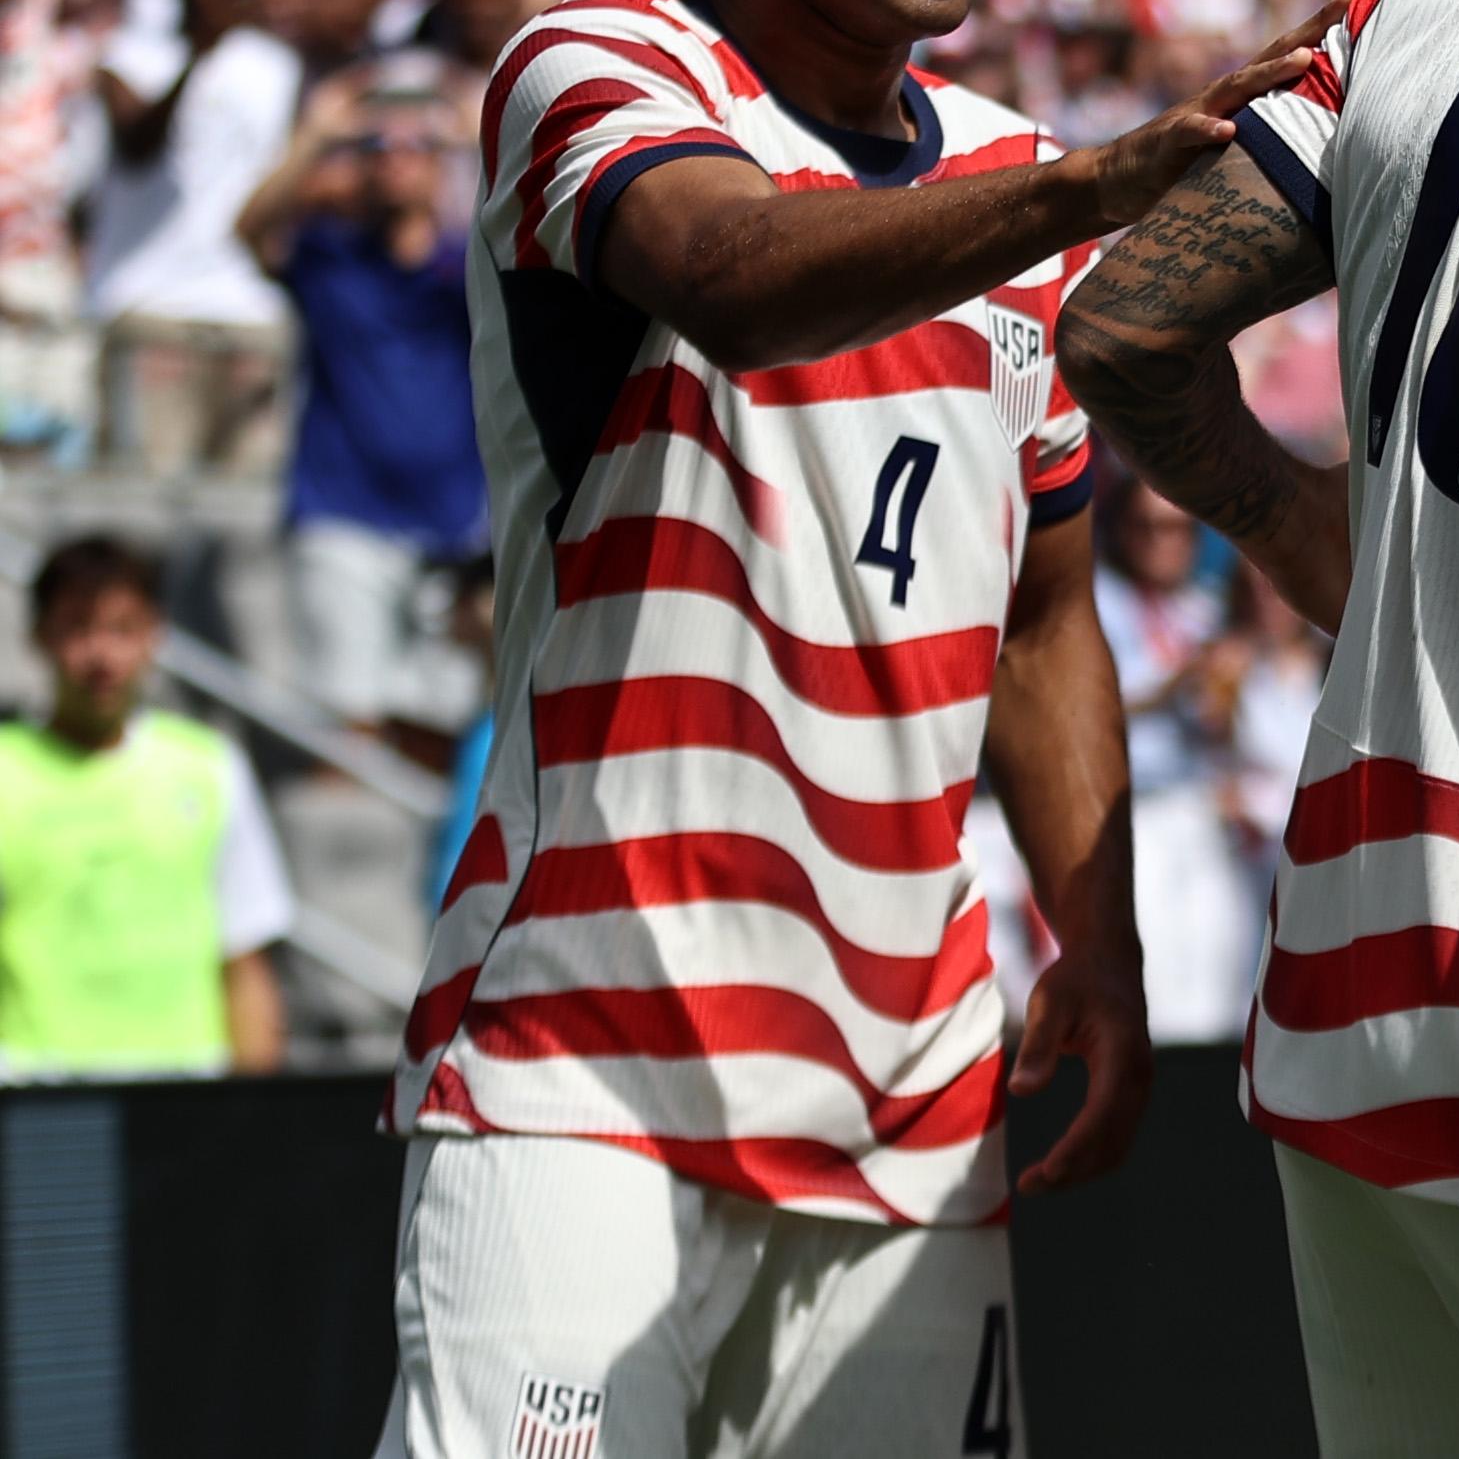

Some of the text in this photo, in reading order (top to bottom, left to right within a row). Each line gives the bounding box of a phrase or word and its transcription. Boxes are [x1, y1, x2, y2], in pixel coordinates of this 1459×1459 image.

[993, 314, 1039, 370] USA
[853, 435, 941, 611] 4
[526, 1380, 600, 1426] USA
[961, 1301, 1012, 1459] 4
